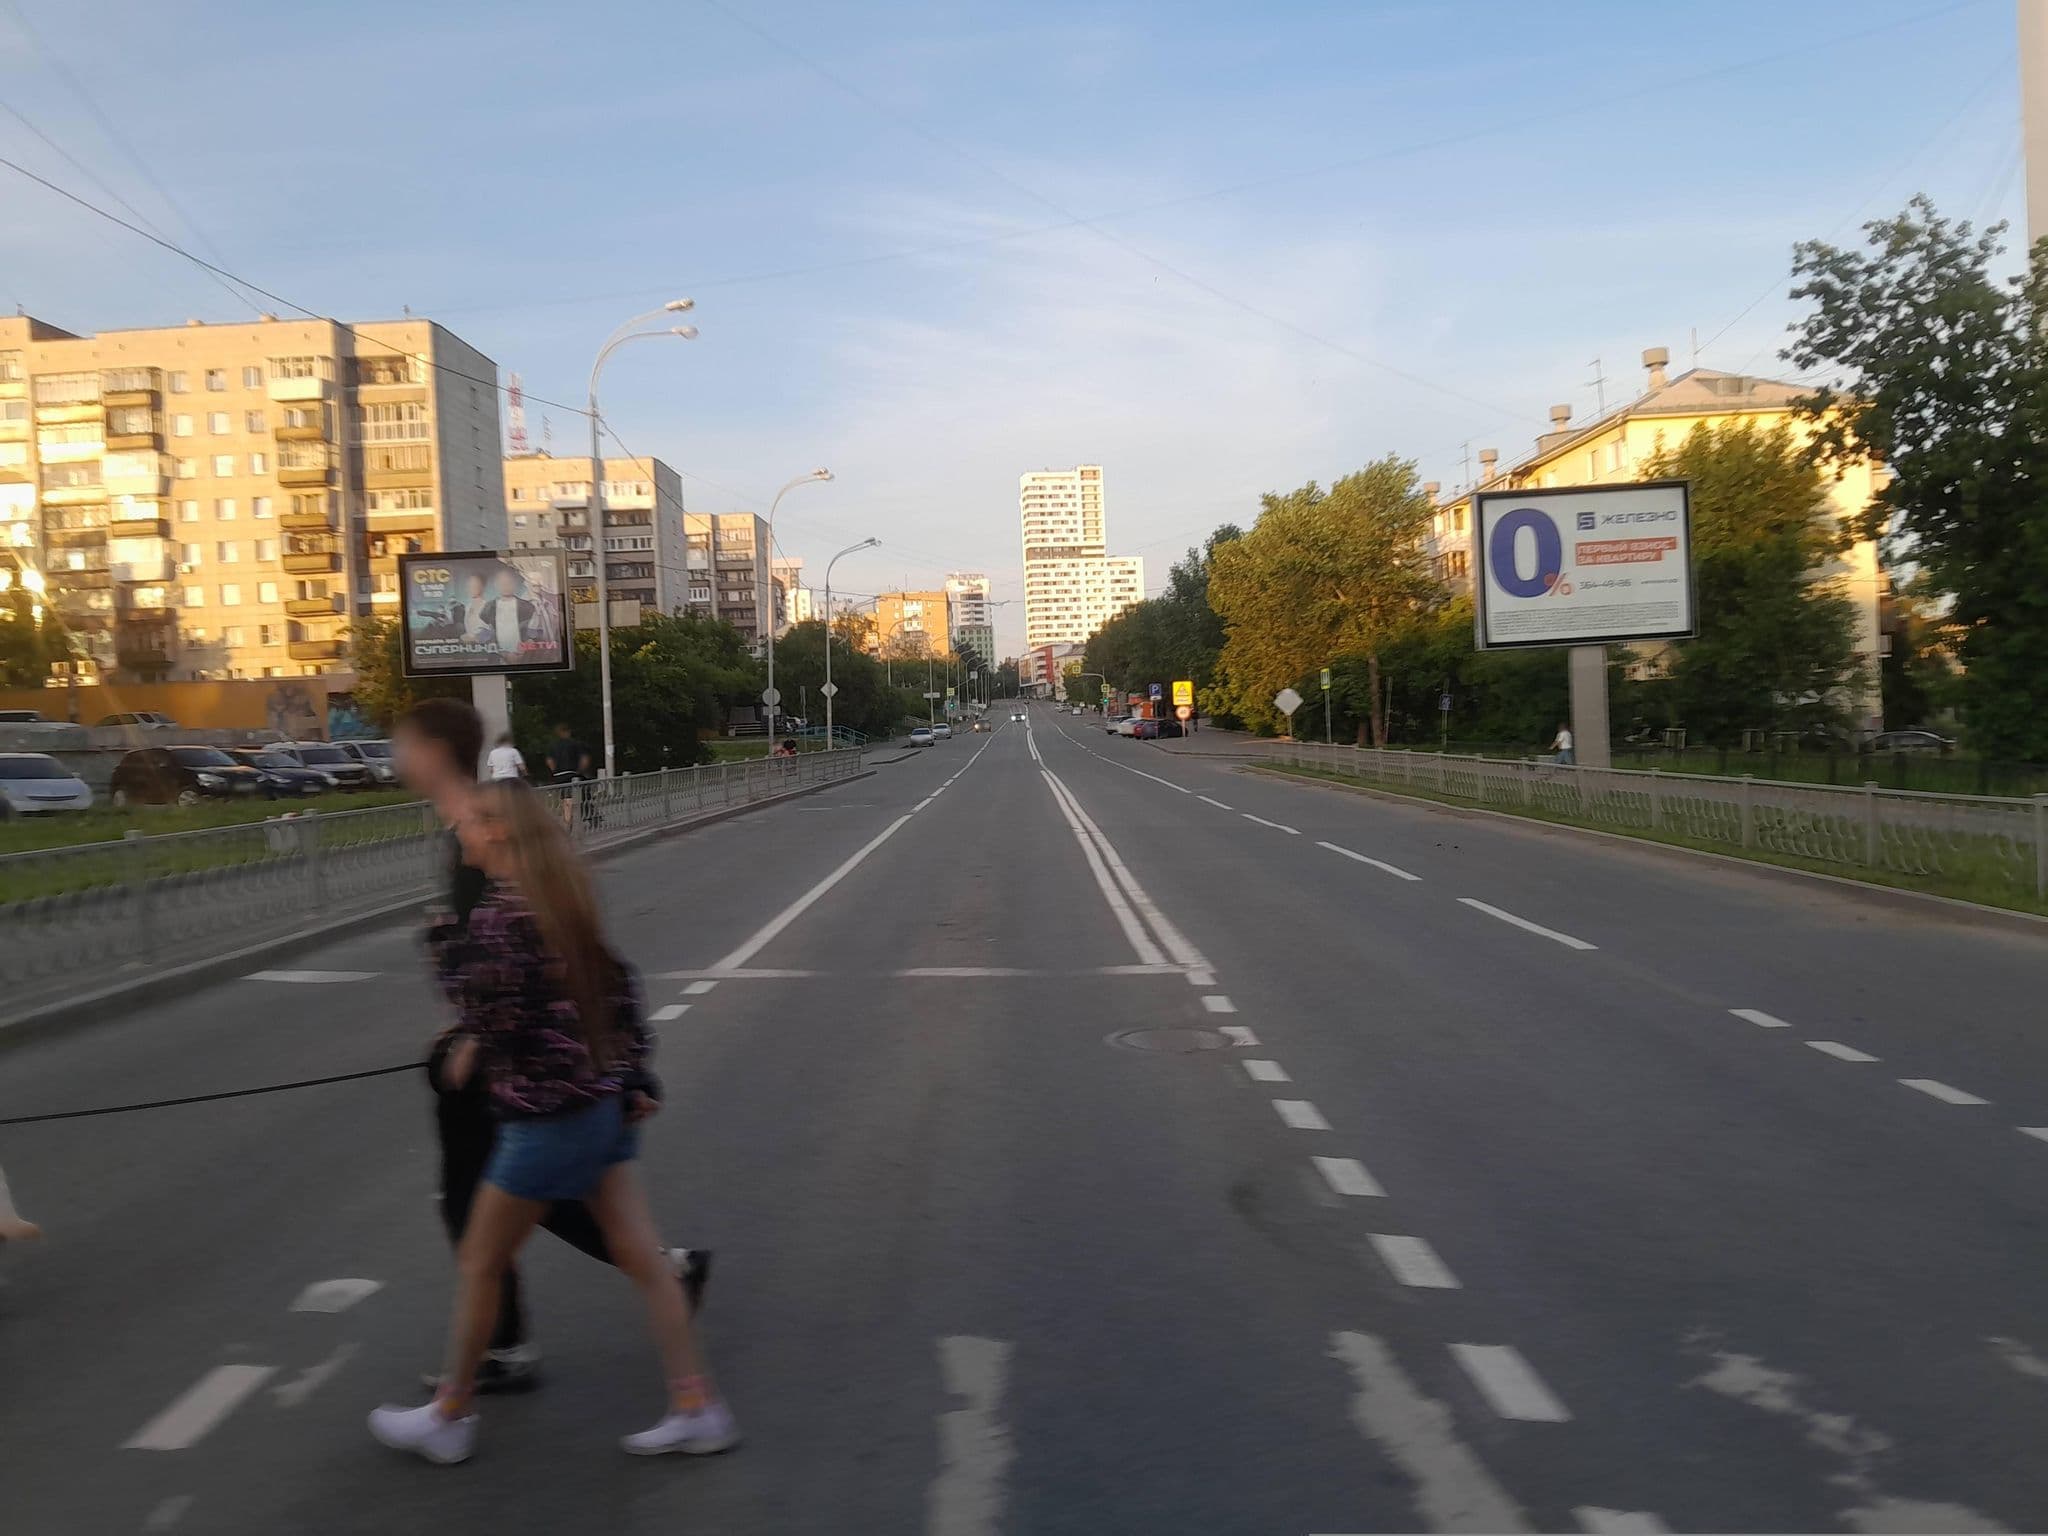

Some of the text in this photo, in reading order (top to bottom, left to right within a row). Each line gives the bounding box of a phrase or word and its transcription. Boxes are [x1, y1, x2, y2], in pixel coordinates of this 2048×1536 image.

[1601, 511, 1677, 525] ЖЕЛЕЗНО
[1578, 543, 1627, 554] ПЕРВЫЙ
[1578, 552, 1656, 563] ЗА КВАРТИРУ
[414, 568, 450, 584] СТС
[517, 640, 557, 651] ДЕТИ
[1152, 685, 1159, 694] P
